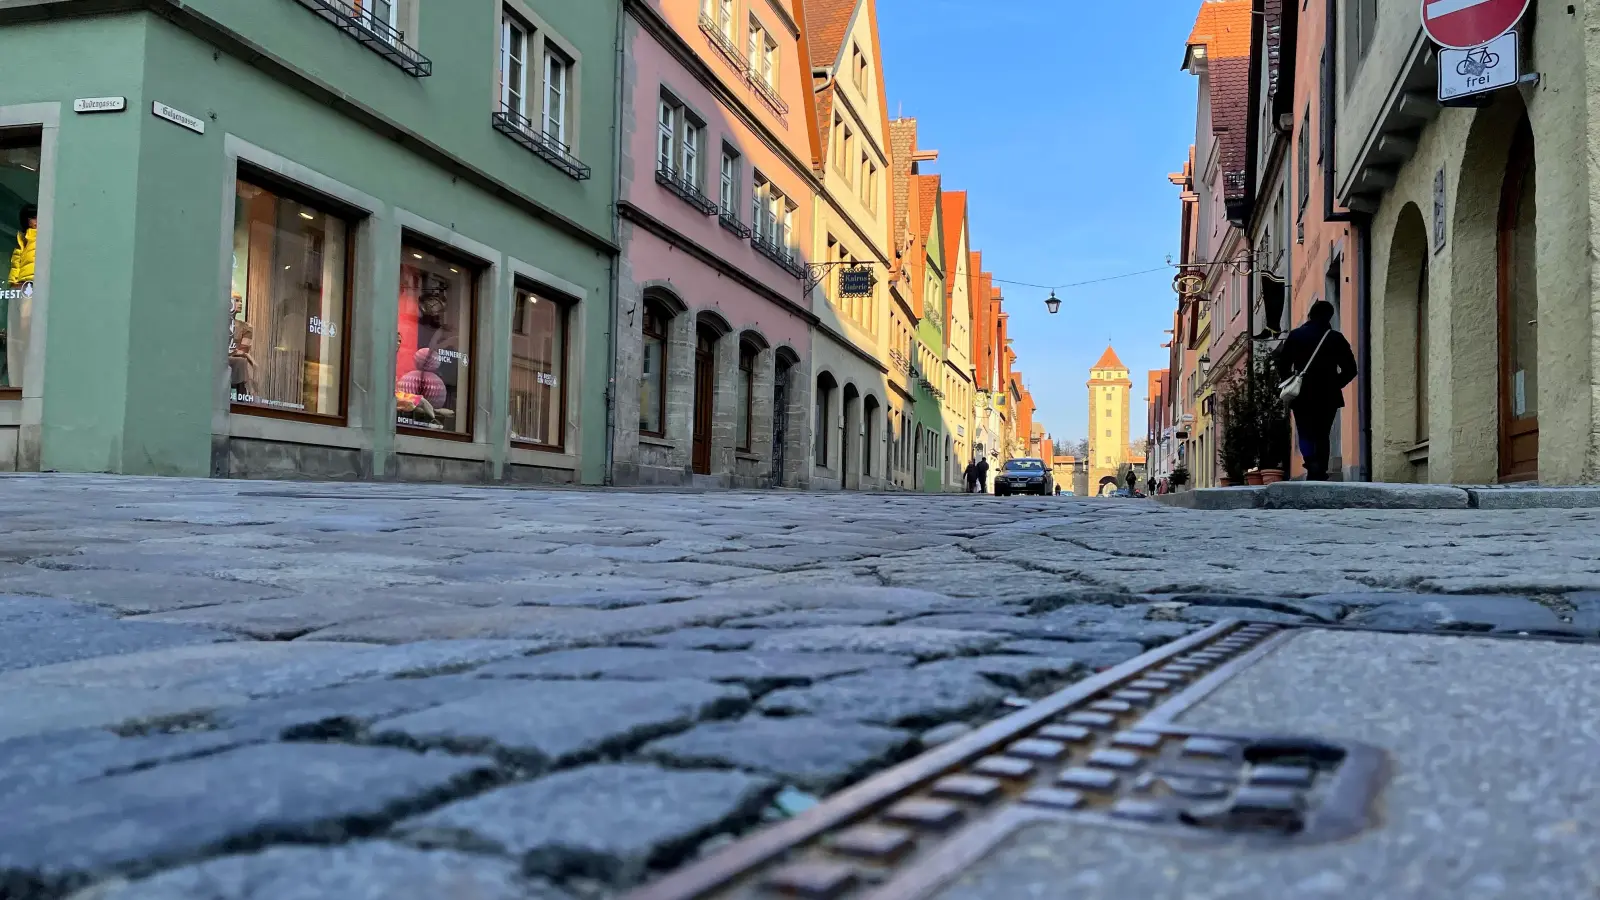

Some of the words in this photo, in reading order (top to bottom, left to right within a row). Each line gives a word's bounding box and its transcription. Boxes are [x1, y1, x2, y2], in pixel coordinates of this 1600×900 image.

[1466, 72, 1490, 88] frei
[81, 99, 116, 110] Judengasse
[237, 393, 254, 402] DICH
[397, 416, 409, 424] DICH
